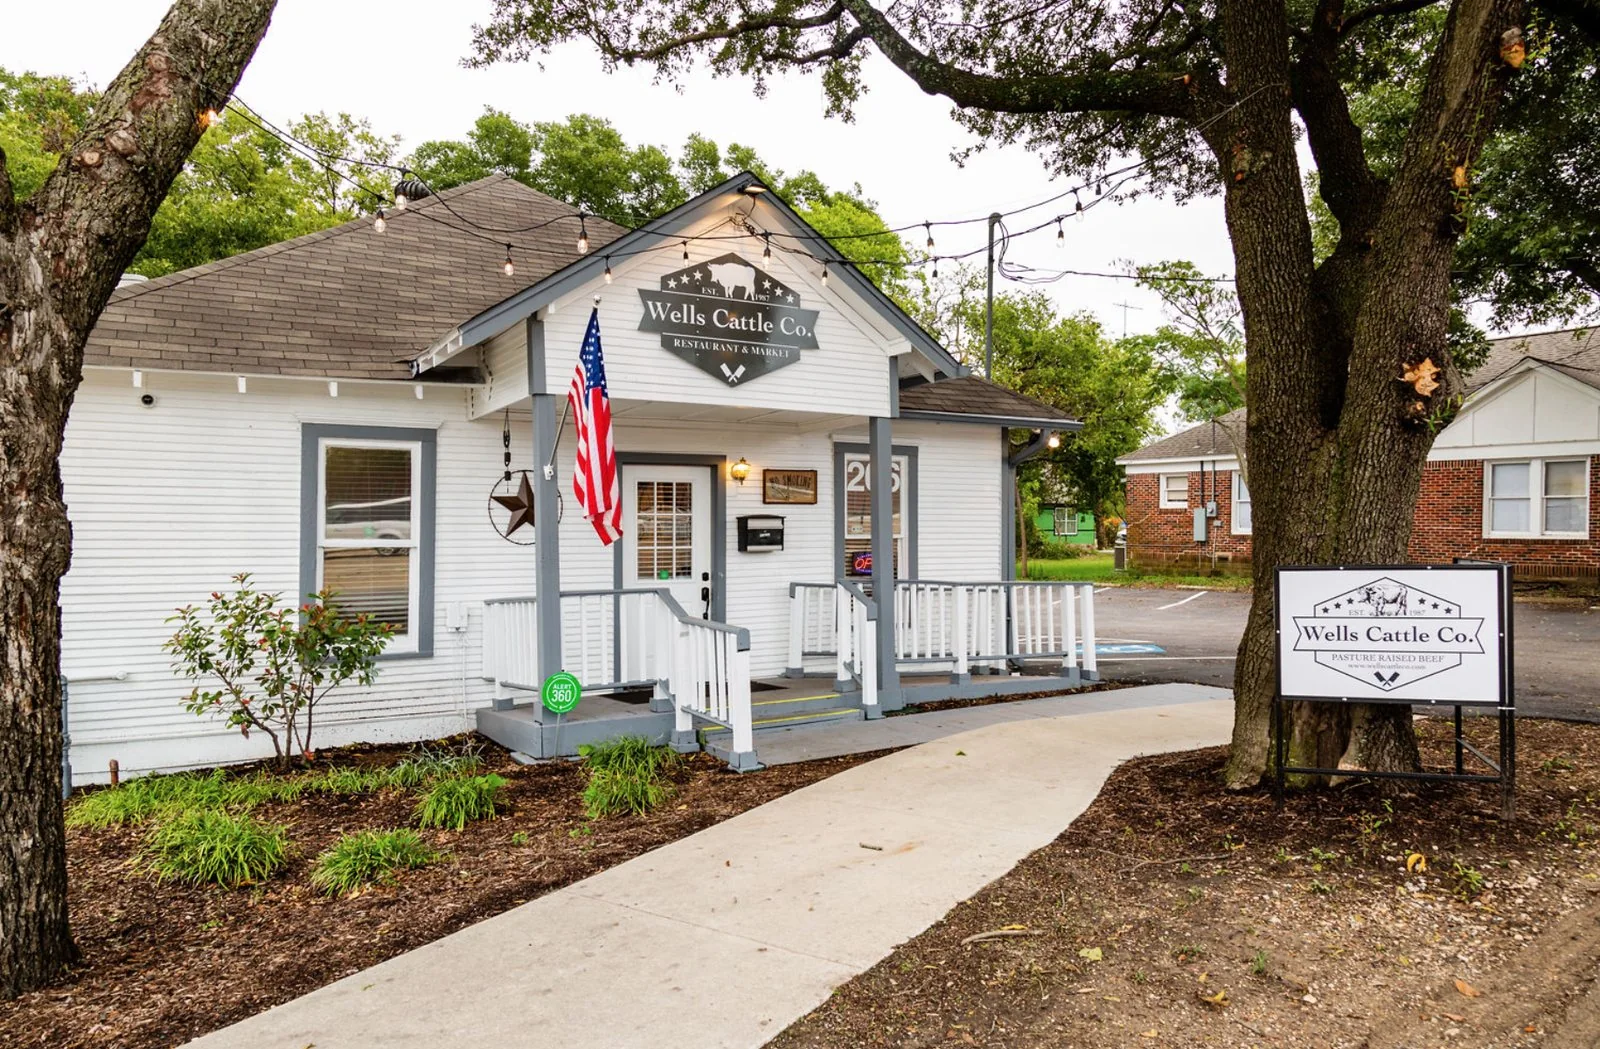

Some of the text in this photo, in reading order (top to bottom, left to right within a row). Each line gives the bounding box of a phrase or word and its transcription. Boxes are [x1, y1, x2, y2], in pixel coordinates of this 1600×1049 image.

[647, 300, 812, 337] Wells Cattle Co.
[674, 338, 789, 358] RESTAURANT & MARKET
[1303, 625, 1474, 643] Wells Cattle Co.
[1331, 653, 1445, 663] PASTURE RAISED BEEF
[551, 690, 572, 702] 360
